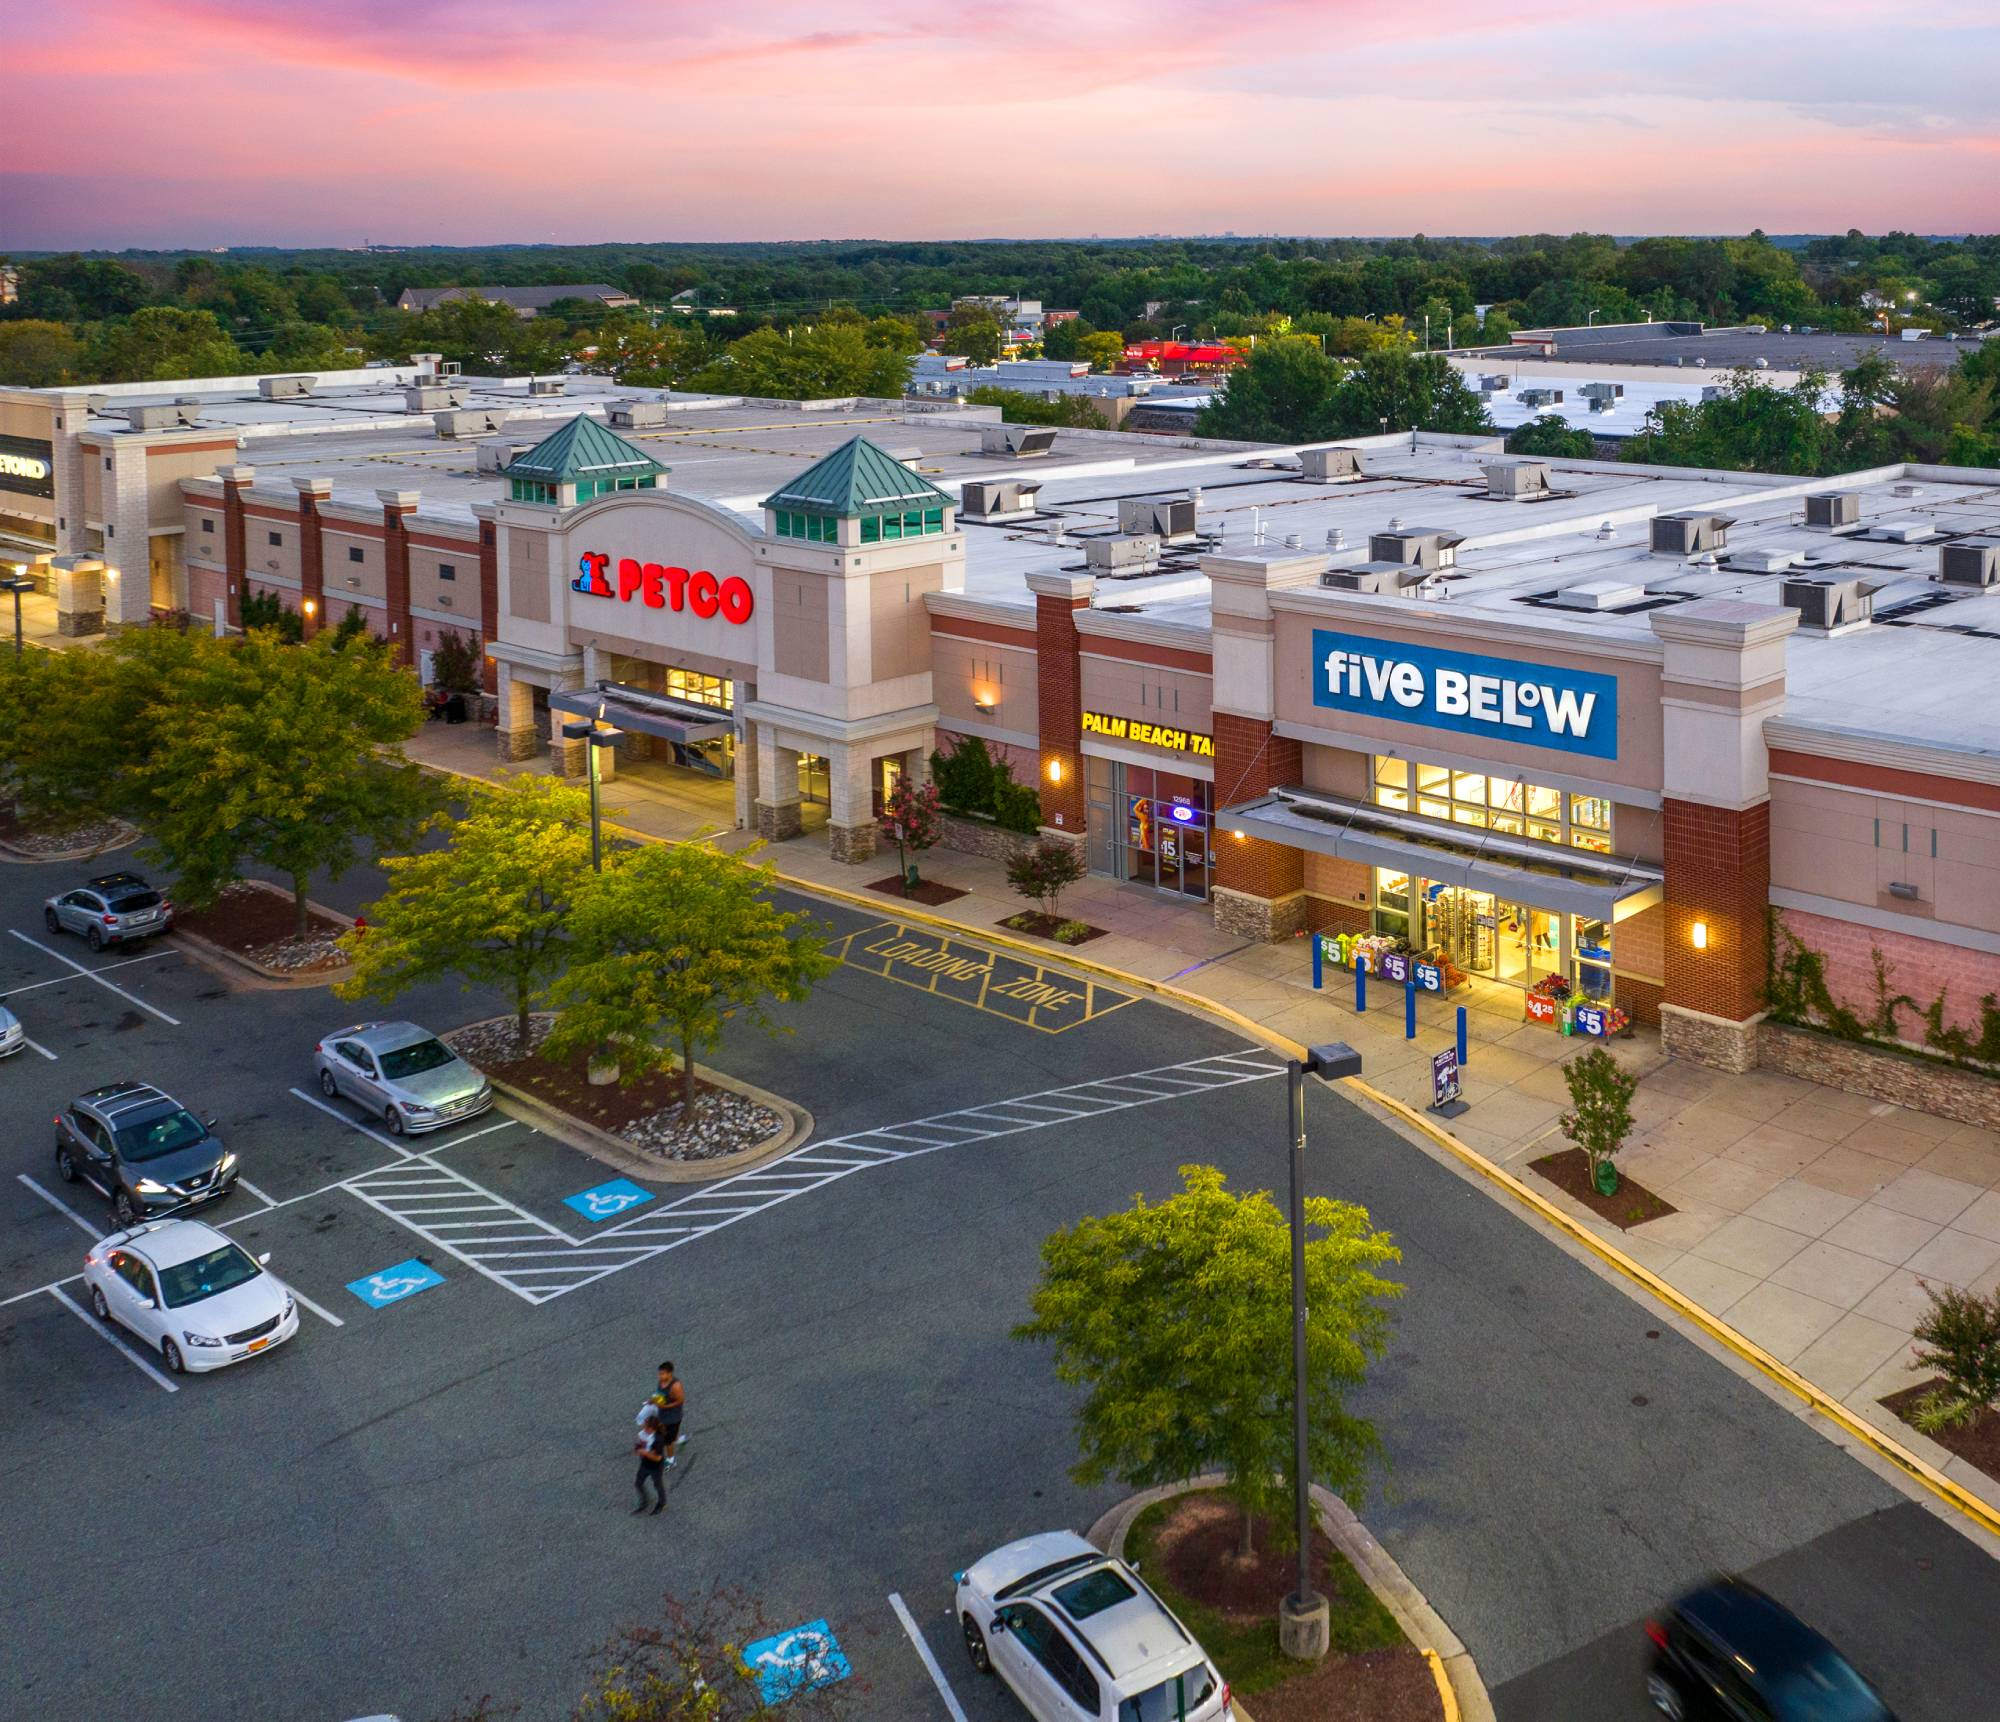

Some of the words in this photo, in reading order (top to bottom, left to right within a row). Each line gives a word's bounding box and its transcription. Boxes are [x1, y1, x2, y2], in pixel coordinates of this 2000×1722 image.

[618, 558, 754, 625] PETCO
[1324, 650, 1425, 708] five
[1082, 712, 1127, 738] PALM
[1129, 721, 1187, 751] BEACH
[1190, 734, 1215, 757] TA
[1321, 940, 1341, 963] $5
[1385, 957, 1405, 981] $5
[864, 937, 994, 981] LOADING
[989, 976, 1086, 1011] ZONE
[1417, 967, 1439, 991] $5
[1578, 1010, 1602, 1035] $5
